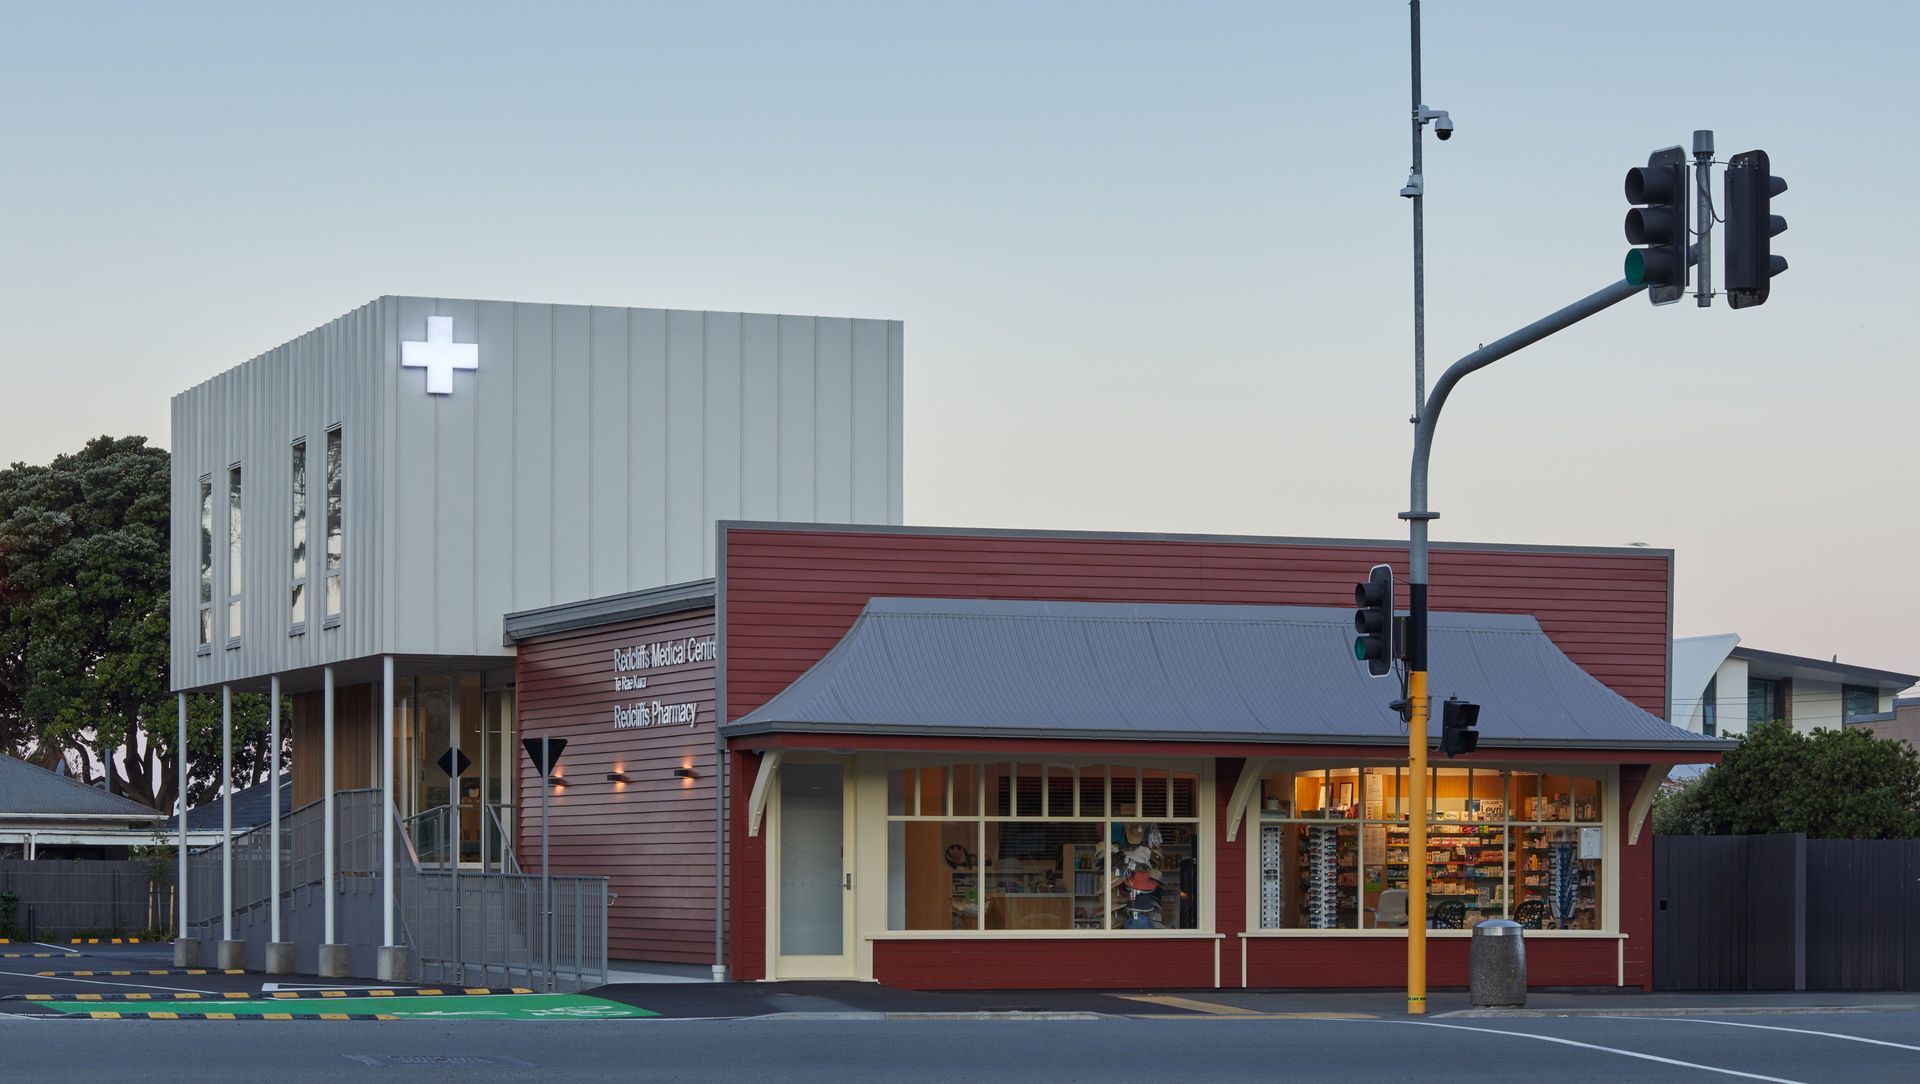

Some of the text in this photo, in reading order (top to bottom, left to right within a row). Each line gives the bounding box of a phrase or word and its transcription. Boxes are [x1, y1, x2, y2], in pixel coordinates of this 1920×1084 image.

[614, 645, 650, 672] Redcliffs
[651, 639, 686, 668] Medical
[614, 674, 647, 691] Te Rae Kura
[614, 700, 697, 728] Redcliffs Pharmacy
